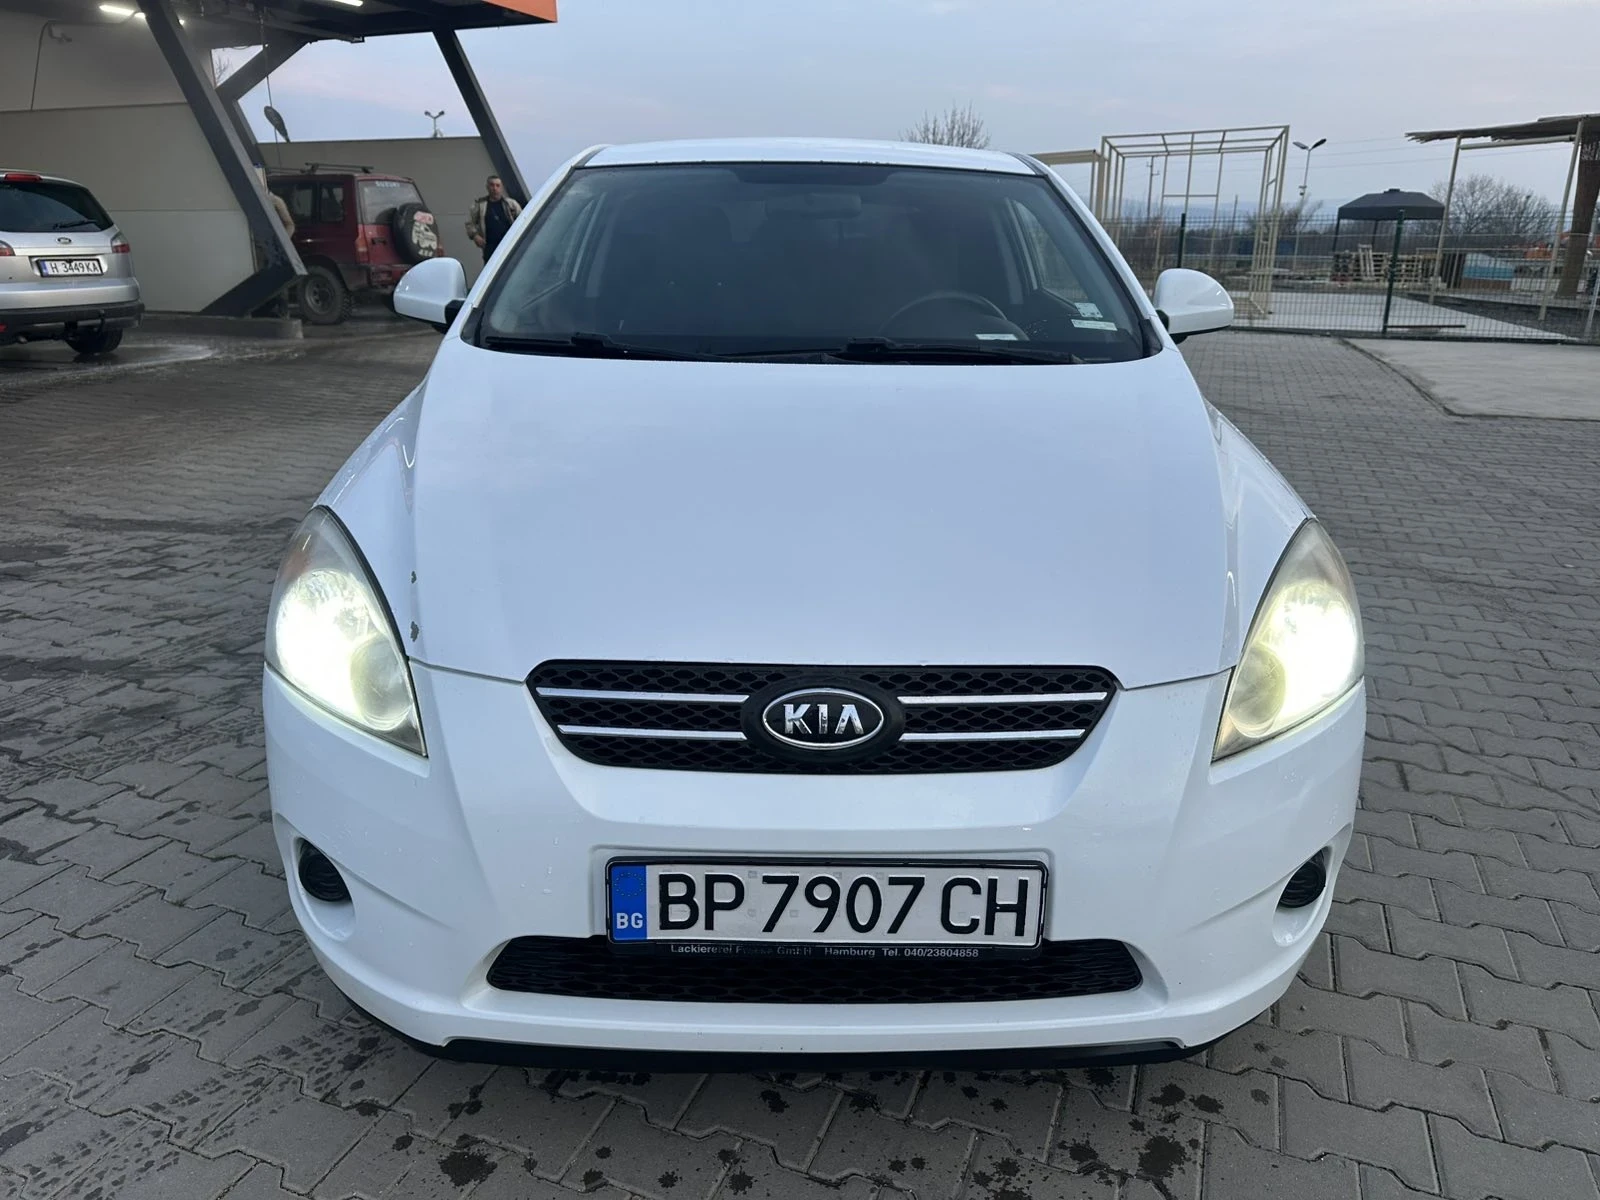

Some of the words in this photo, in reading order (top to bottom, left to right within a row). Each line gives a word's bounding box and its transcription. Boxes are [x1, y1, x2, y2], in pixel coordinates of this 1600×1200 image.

[50, 262, 59, 273] H
[783, 703, 864, 735] KIA
[658, 872, 745, 931] BP
[761, 873, 926, 935] 7907
[940, 875, 1029, 937] CH
[616, 912, 644, 929] BG
[824, 947, 876, 958] Hamburg
[903, 948, 979, 958] 040/23804858
